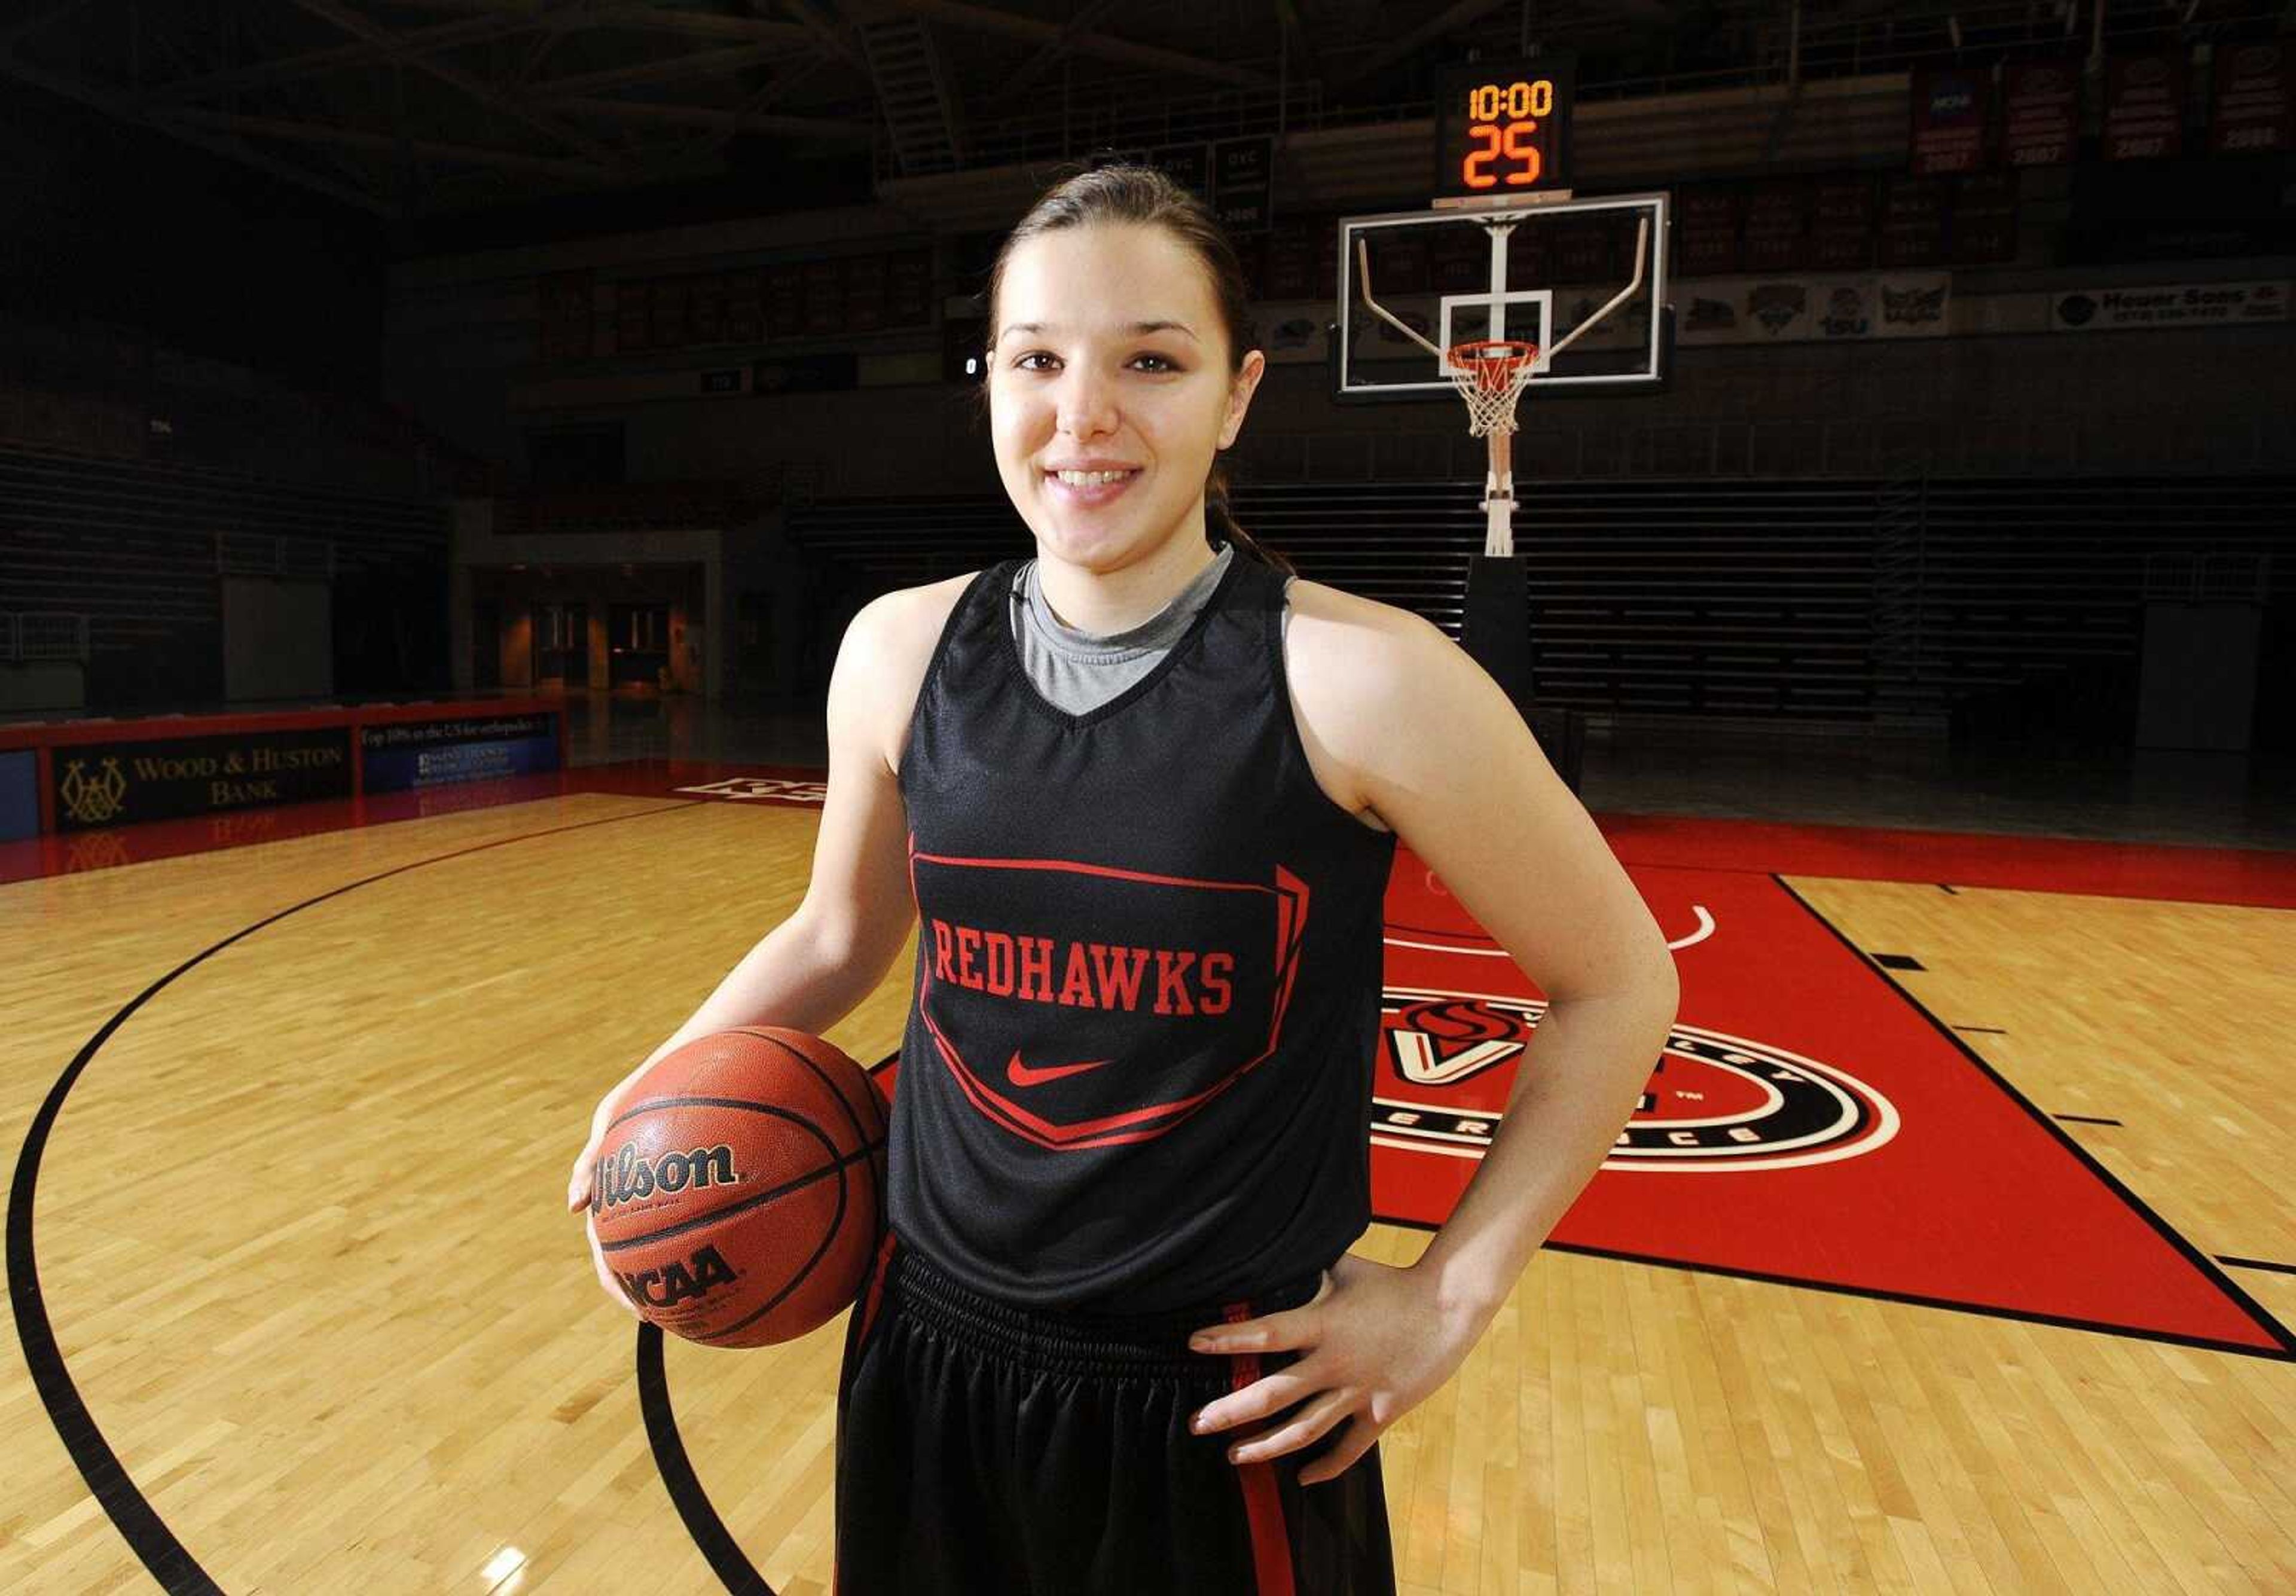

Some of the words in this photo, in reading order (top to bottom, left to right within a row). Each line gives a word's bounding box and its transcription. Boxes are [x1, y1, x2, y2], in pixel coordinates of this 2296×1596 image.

[1470, 80, 1552, 121] 10:00
[1464, 121, 1540, 188] 25
[223, 751, 246, 775] &
[209, 780, 278, 805] BANK
[932, 918, 1234, 1015] REDHAWKS
[614, 1244, 738, 1308] NCAA
